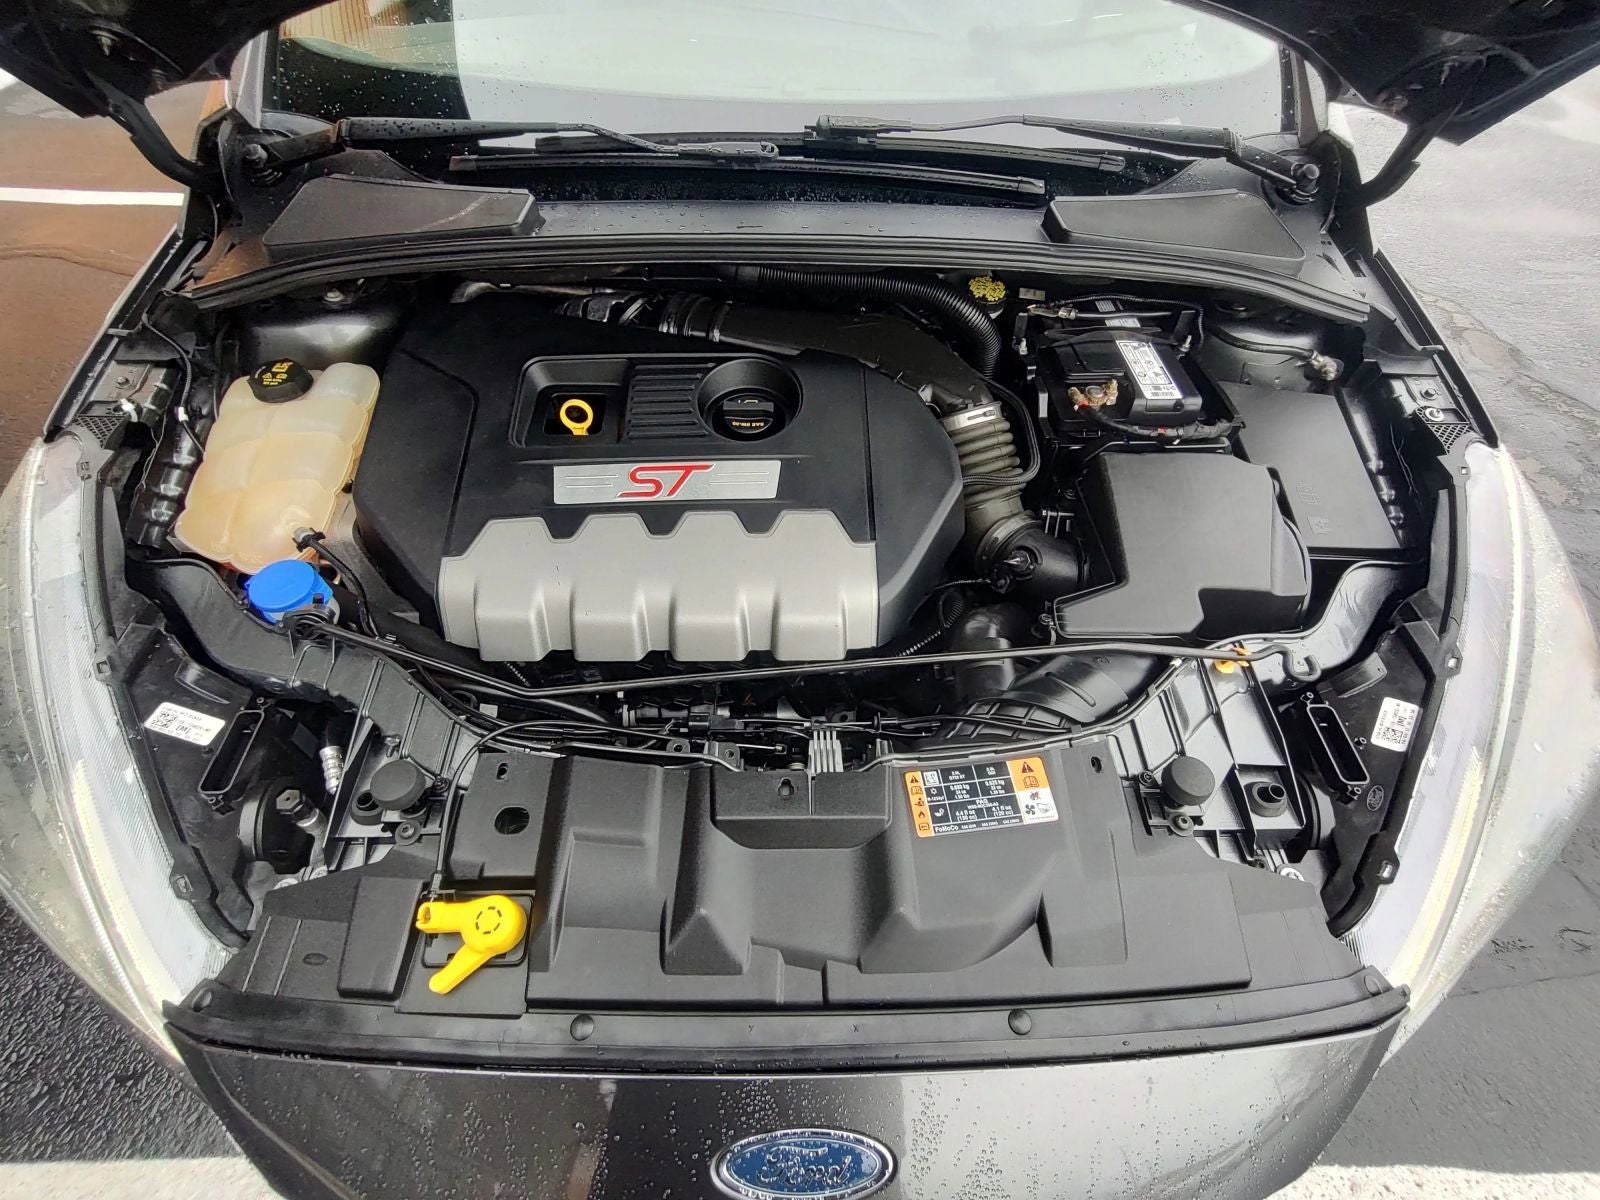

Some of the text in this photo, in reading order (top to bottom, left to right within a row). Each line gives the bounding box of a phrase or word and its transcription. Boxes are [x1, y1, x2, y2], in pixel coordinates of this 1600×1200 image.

[615, 463, 716, 501] ST
[934, 825, 959, 833] FoMoCo
[756, 1145, 852, 1185] Ford
